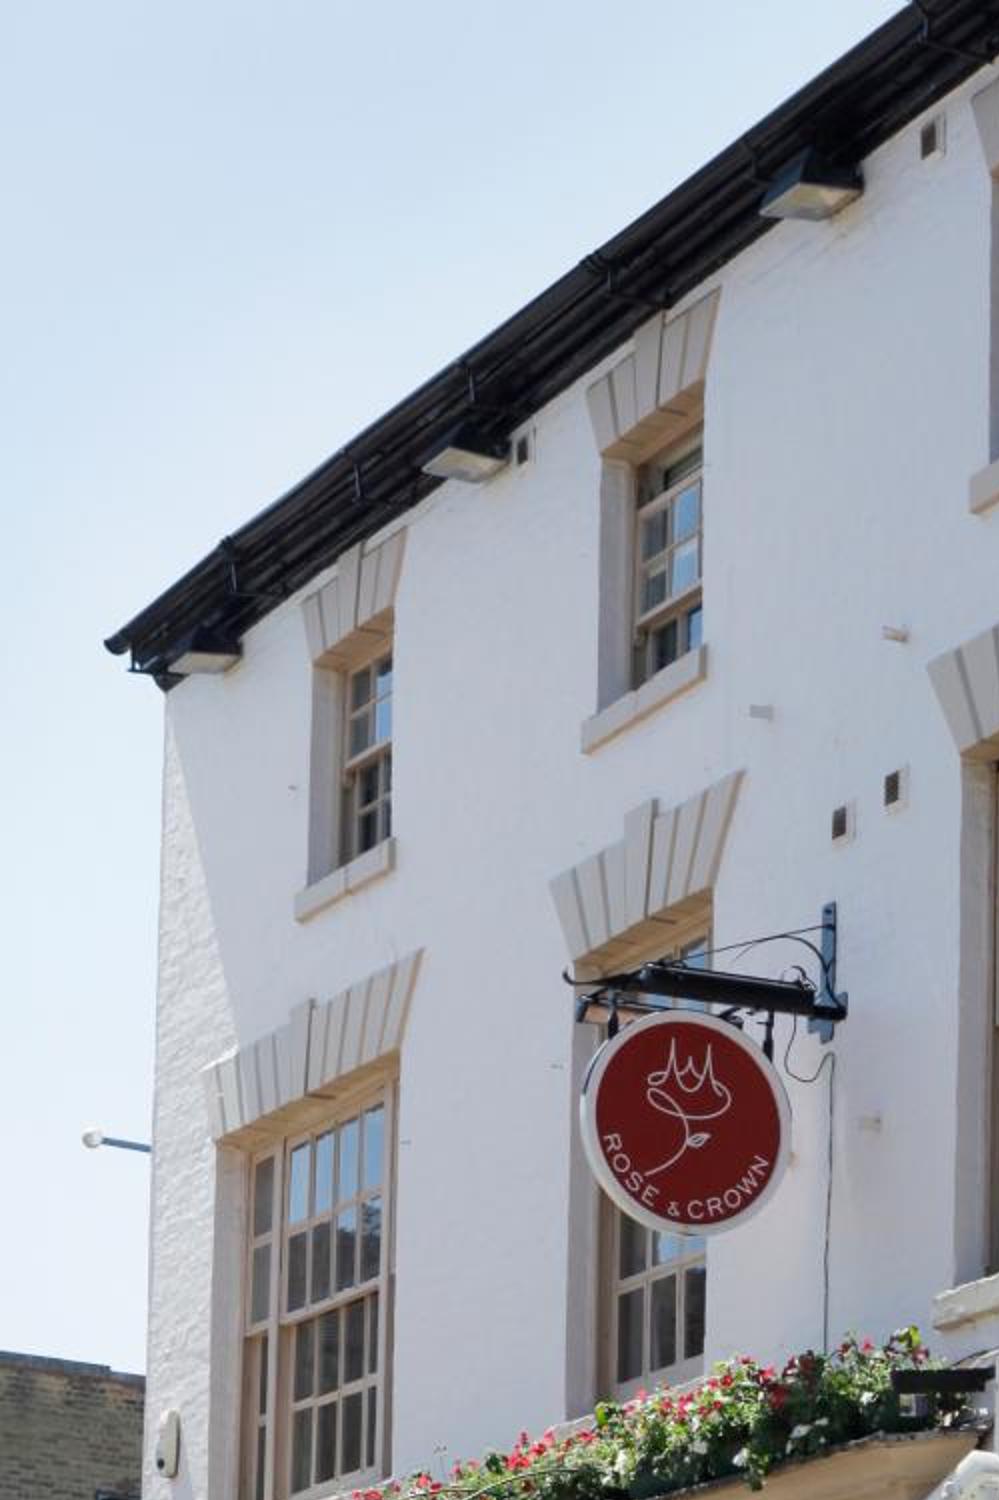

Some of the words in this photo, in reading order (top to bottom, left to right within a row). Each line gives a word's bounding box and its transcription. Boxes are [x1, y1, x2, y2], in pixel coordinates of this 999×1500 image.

[603, 1133, 660, 1207] ROSE
[667, 1201, 681, 1217] &
[687, 1155, 769, 1220] CROWN
